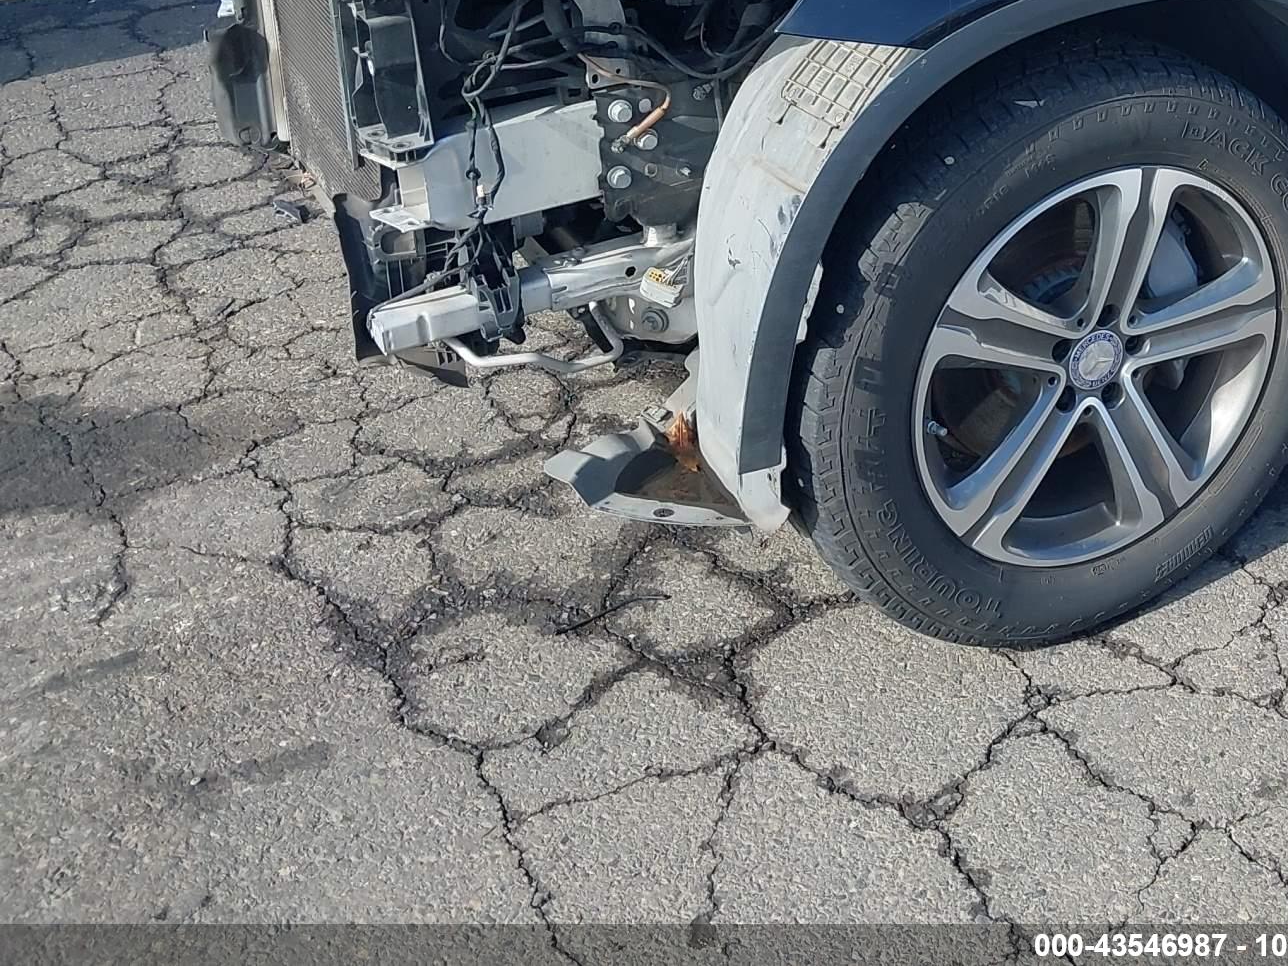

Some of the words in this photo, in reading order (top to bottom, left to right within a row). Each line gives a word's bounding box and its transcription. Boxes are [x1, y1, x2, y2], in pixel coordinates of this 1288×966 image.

[1181, 120, 1270, 176] BACK
[1075, 333, 1111, 358] MERCEDES
[876, 498, 1003, 619] TOURING
